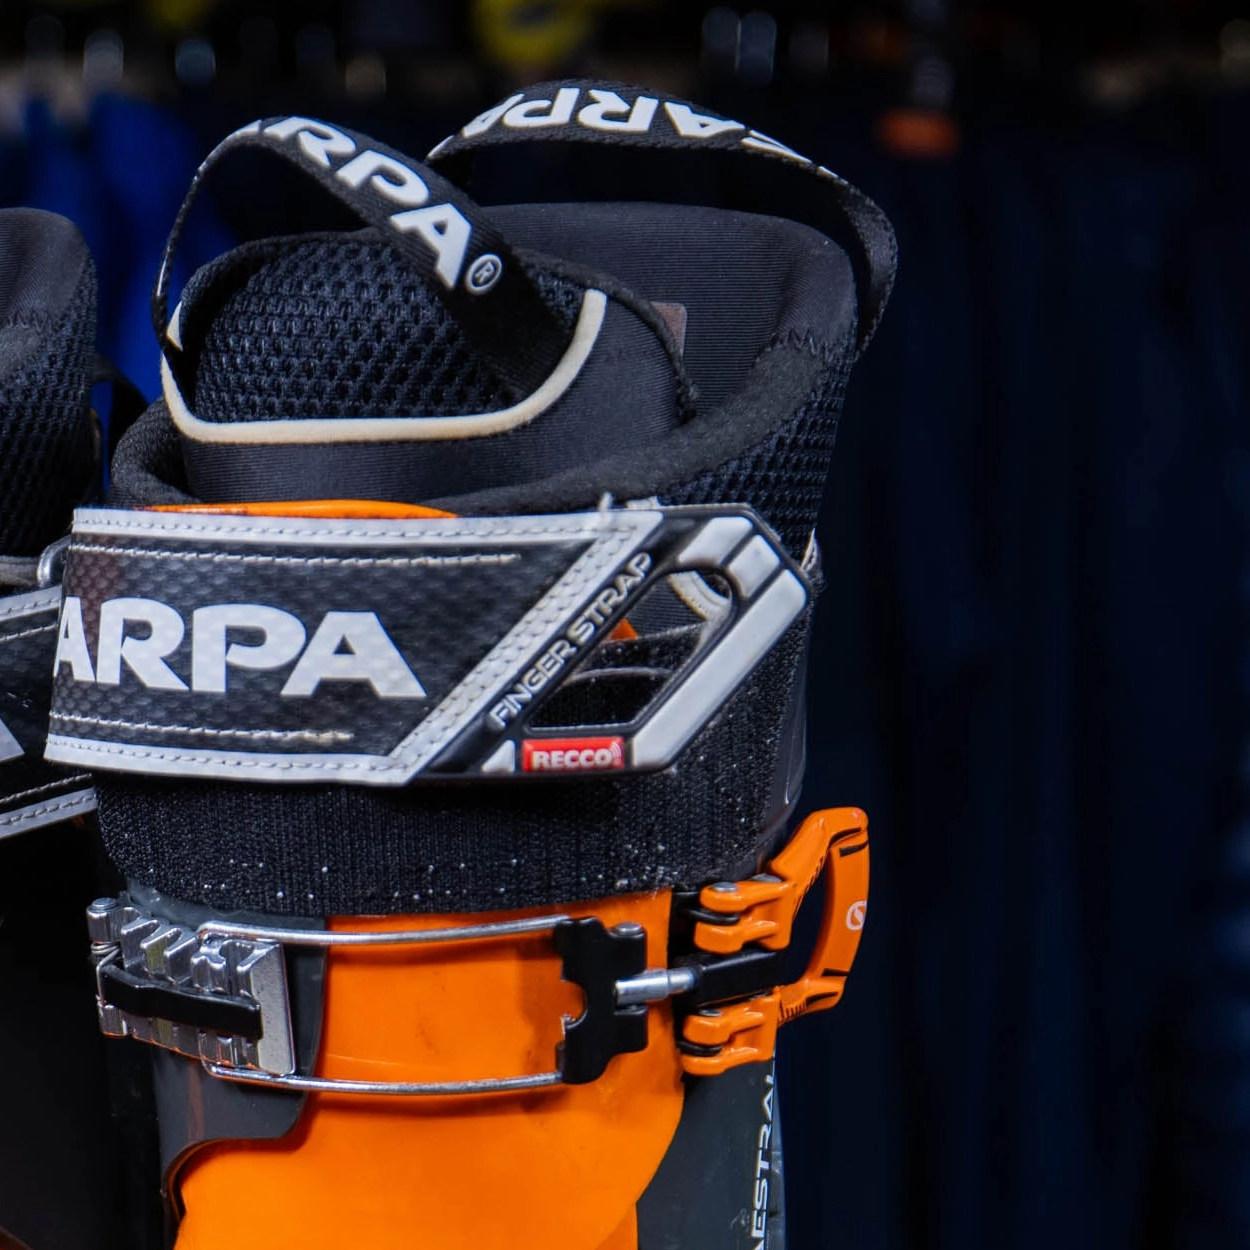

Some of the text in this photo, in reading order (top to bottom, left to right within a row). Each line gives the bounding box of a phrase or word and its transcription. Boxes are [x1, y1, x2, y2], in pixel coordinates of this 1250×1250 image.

[487, 551, 652, 730] FINGER STRAP
[532, 748, 613, 769] RECCO
